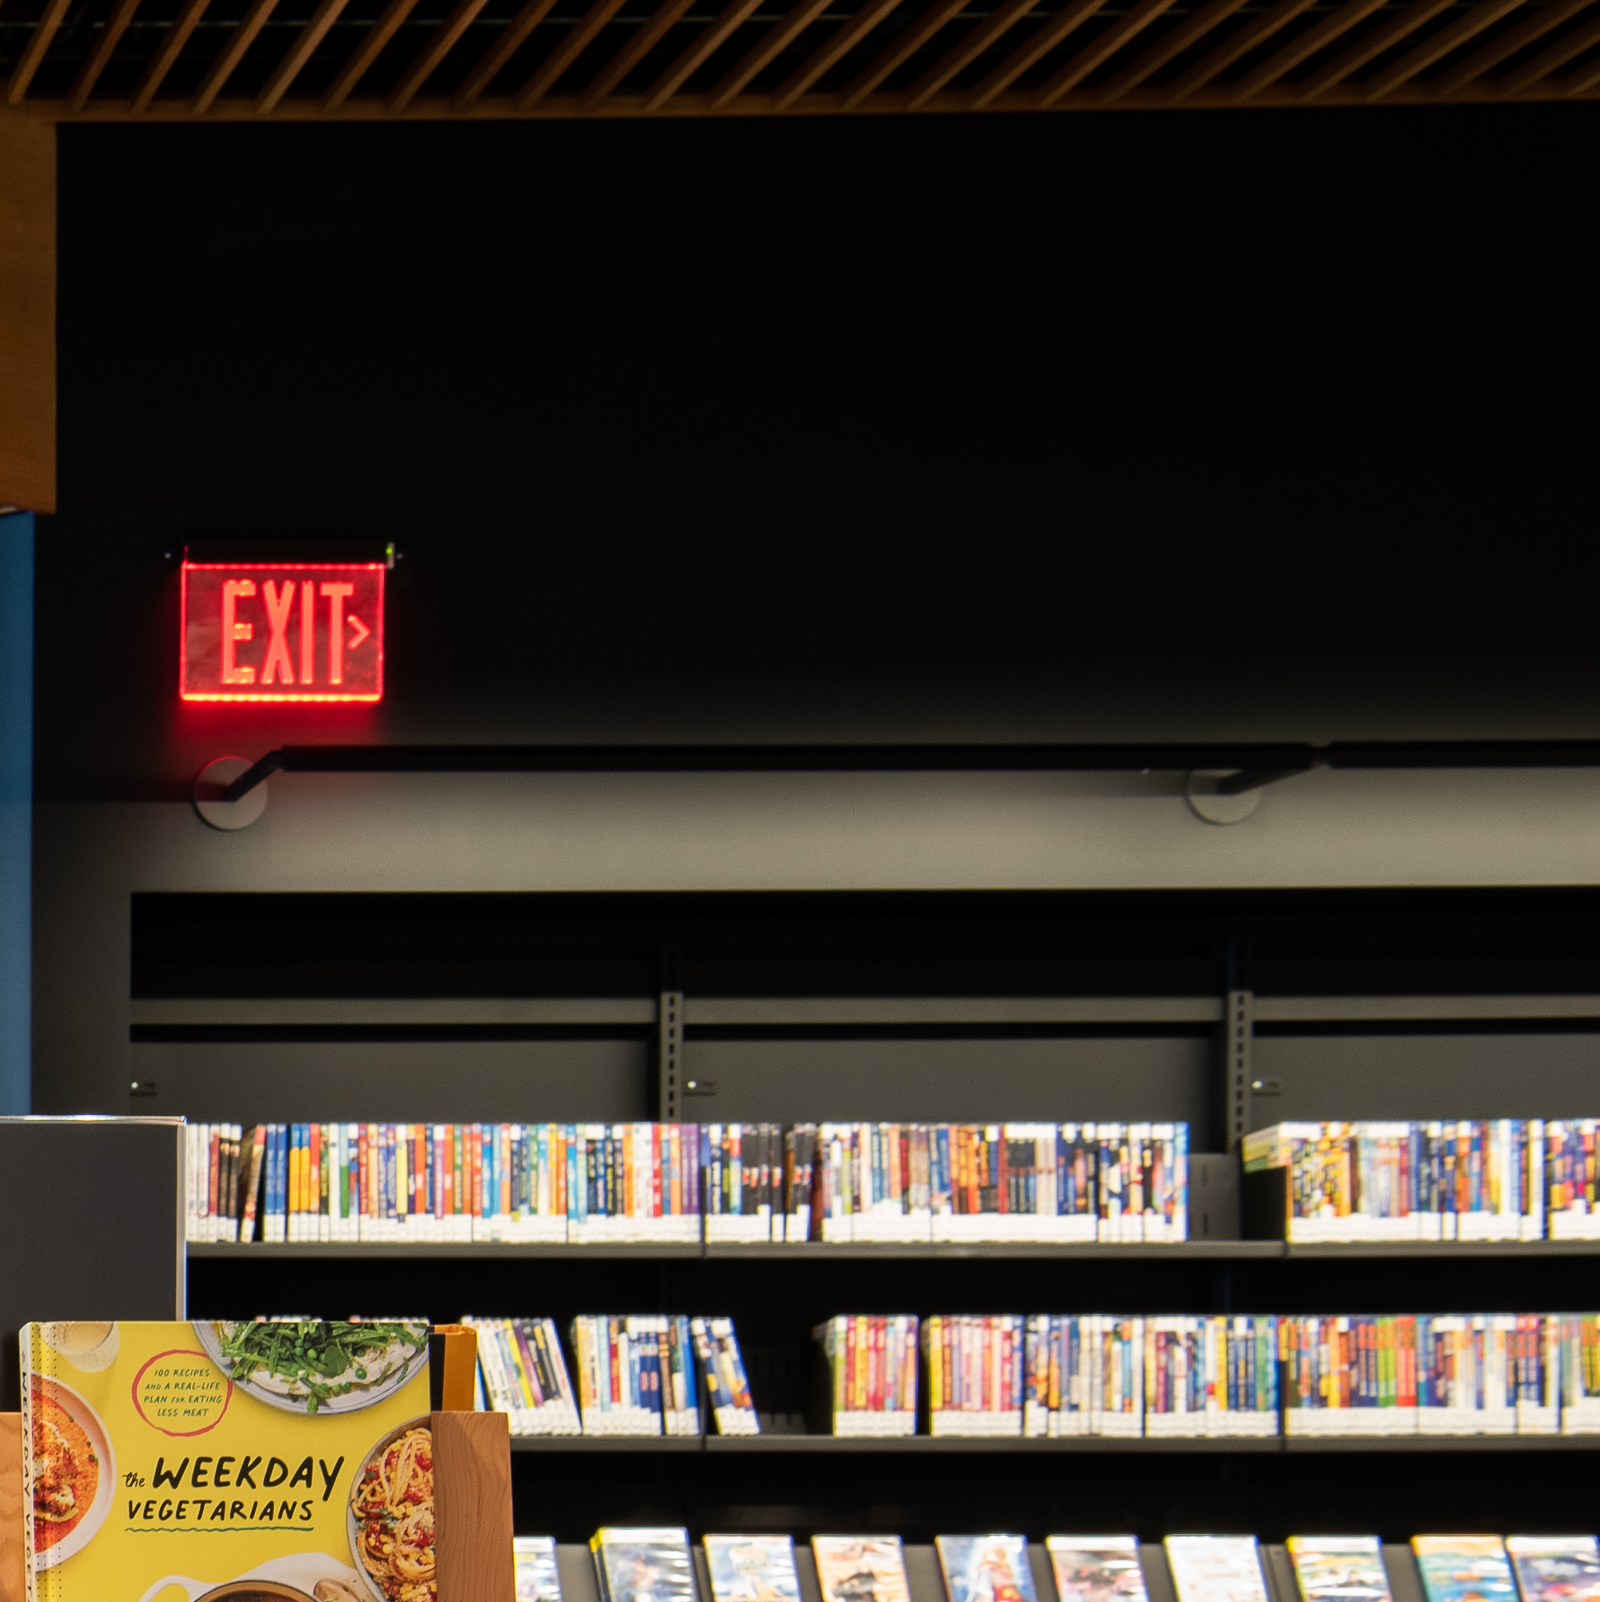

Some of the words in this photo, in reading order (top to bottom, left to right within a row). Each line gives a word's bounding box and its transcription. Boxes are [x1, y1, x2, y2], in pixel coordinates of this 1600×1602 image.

[220, 580, 354, 685] EXIT
[122, 1472, 145, 1488] the
[152, 1455, 345, 1501] WEEKDAY
[128, 1499, 314, 1521] VEGETARIANS
